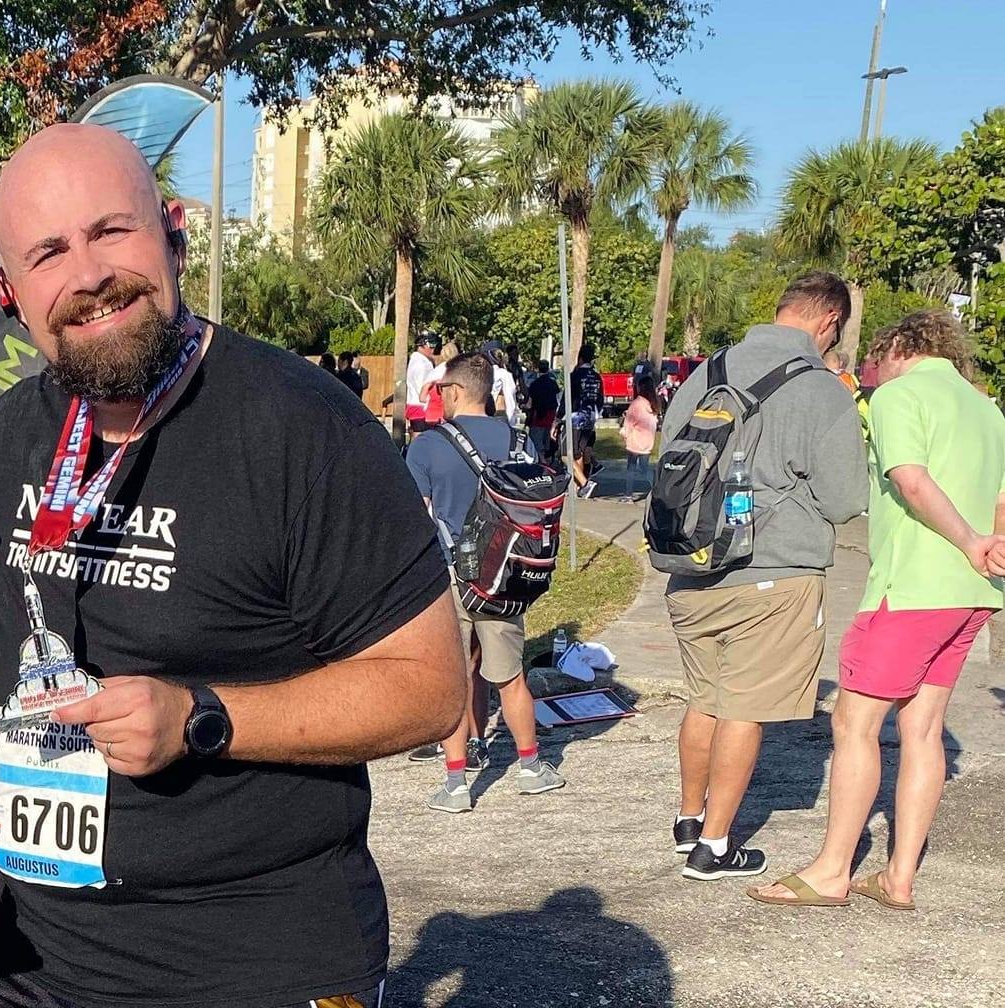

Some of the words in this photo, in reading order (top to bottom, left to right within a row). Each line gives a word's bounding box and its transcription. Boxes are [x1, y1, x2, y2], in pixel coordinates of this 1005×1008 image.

[48, 455, 78, 512] GEMINI
[93, 497, 177, 548] EAR
[5, 541, 175, 592] TRNITYFITNESS
[5, 730, 57, 750] MARATHON
[59, 735, 96, 754] SOUTH
[10, 794, 99, 855] 6706
[5, 855, 60, 877] AUGUSTUS
